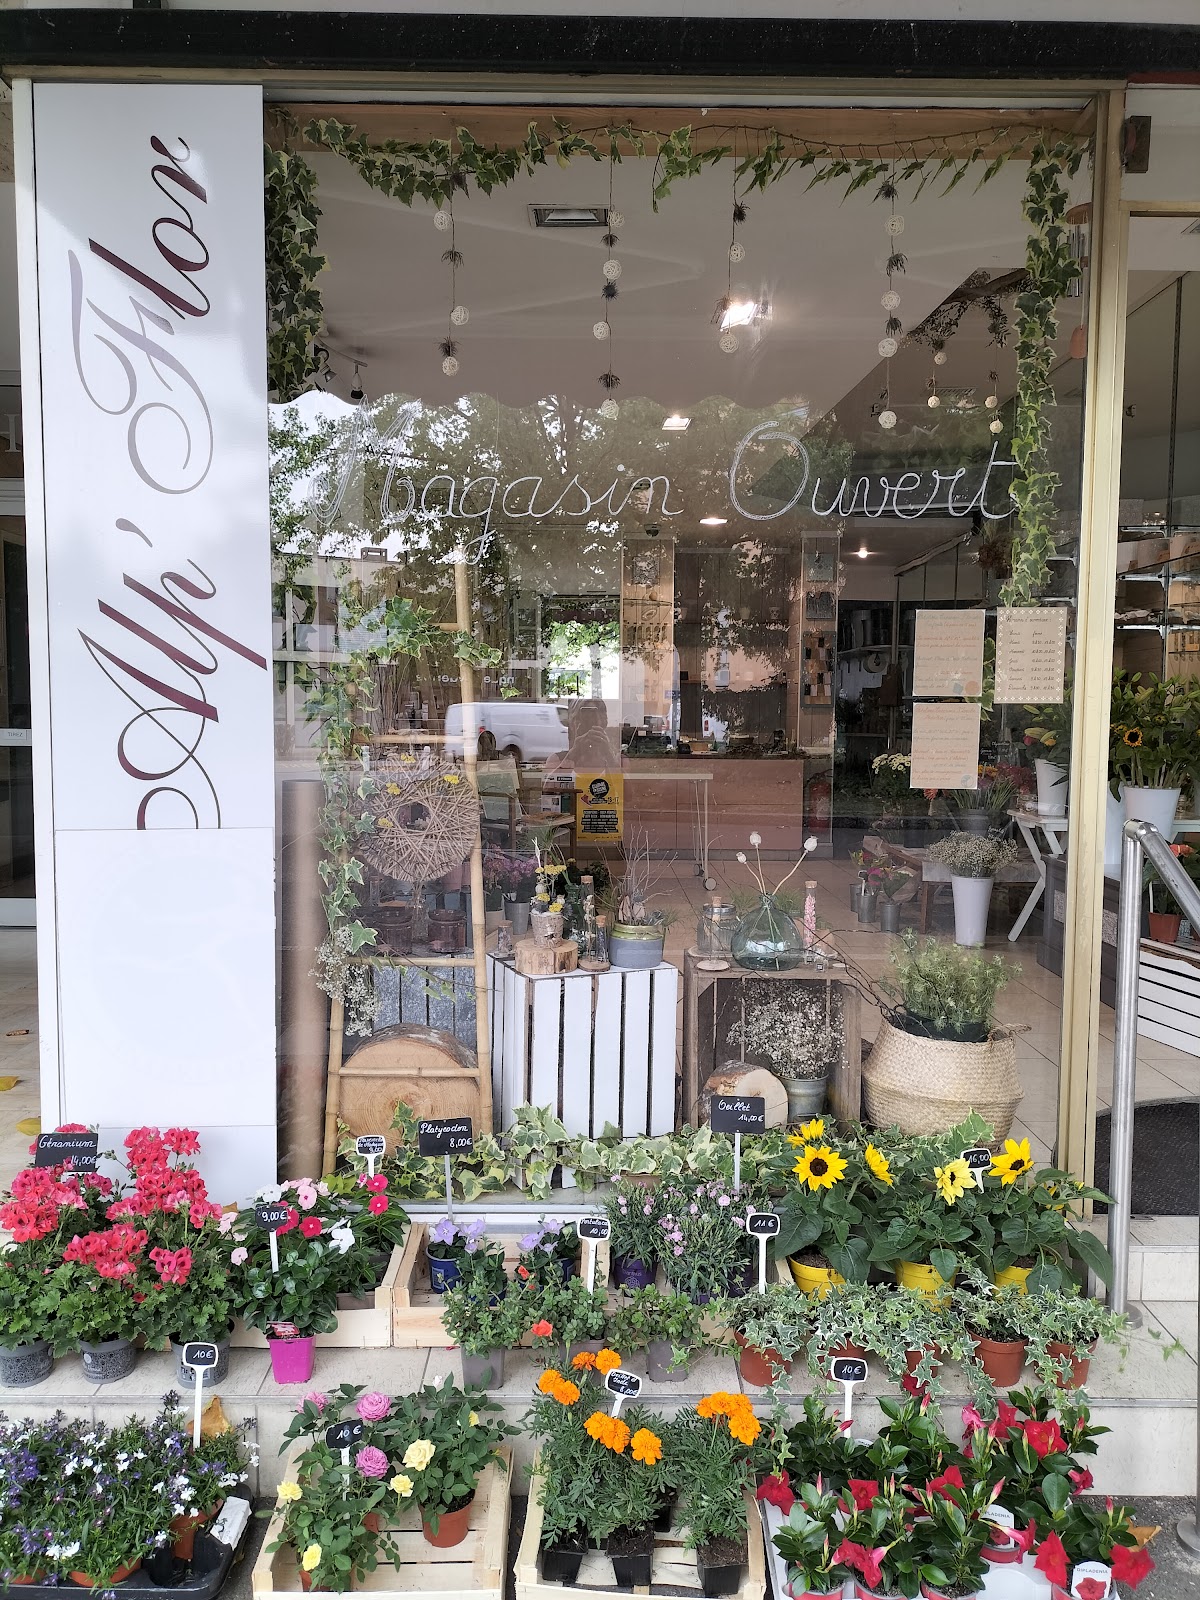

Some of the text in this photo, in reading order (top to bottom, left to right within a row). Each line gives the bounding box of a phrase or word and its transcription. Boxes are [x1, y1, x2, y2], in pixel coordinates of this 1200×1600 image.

[307, 394, 1021, 565] Magasin Ouvert
[420, 1122, 469, 1139] Platycodon
[449, 1137, 473, 1149] 8,00€
[969, 1153, 990, 1164] 16,00
[261, 1210, 288, 1223] 9,00€
[193, 1349, 214, 1359] 10€
